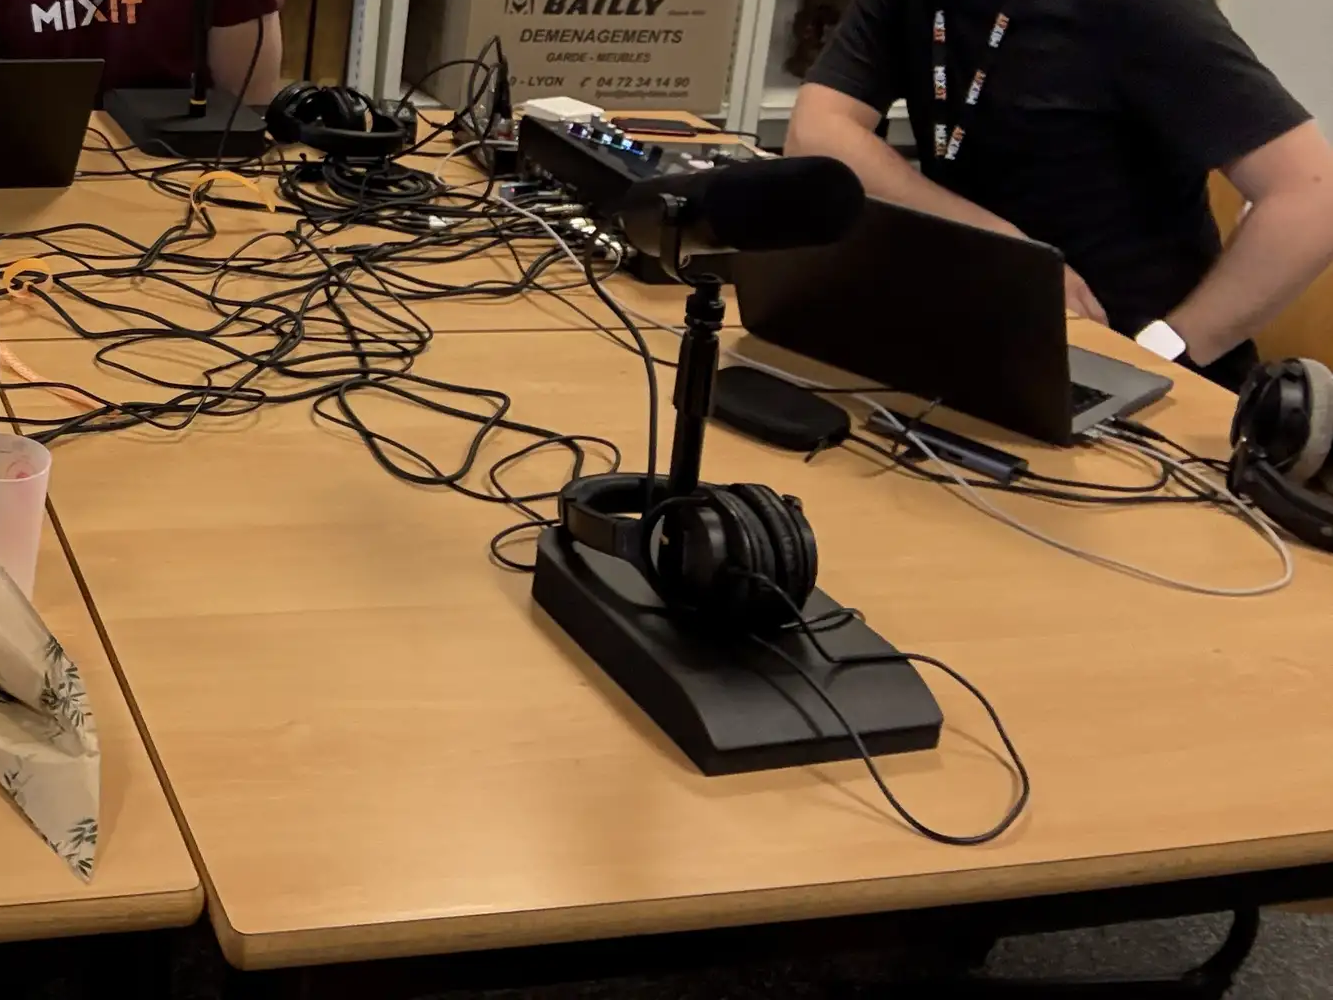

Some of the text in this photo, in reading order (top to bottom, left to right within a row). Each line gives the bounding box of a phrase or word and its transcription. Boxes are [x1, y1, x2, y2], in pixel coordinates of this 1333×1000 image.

[519, 28, 684, 44] DEMENAGEMENTS
[546, 52, 587, 62] GARDE
[596, 52, 651, 63] MEUBLES
[528, 76, 565, 87] LYON
[596, 77, 612, 88] 04
[617, 77, 632, 88] 72
[636, 77, 651, 88] 34
[656, 77, 670, 88] 14
[674, 77, 690, 89] 90
